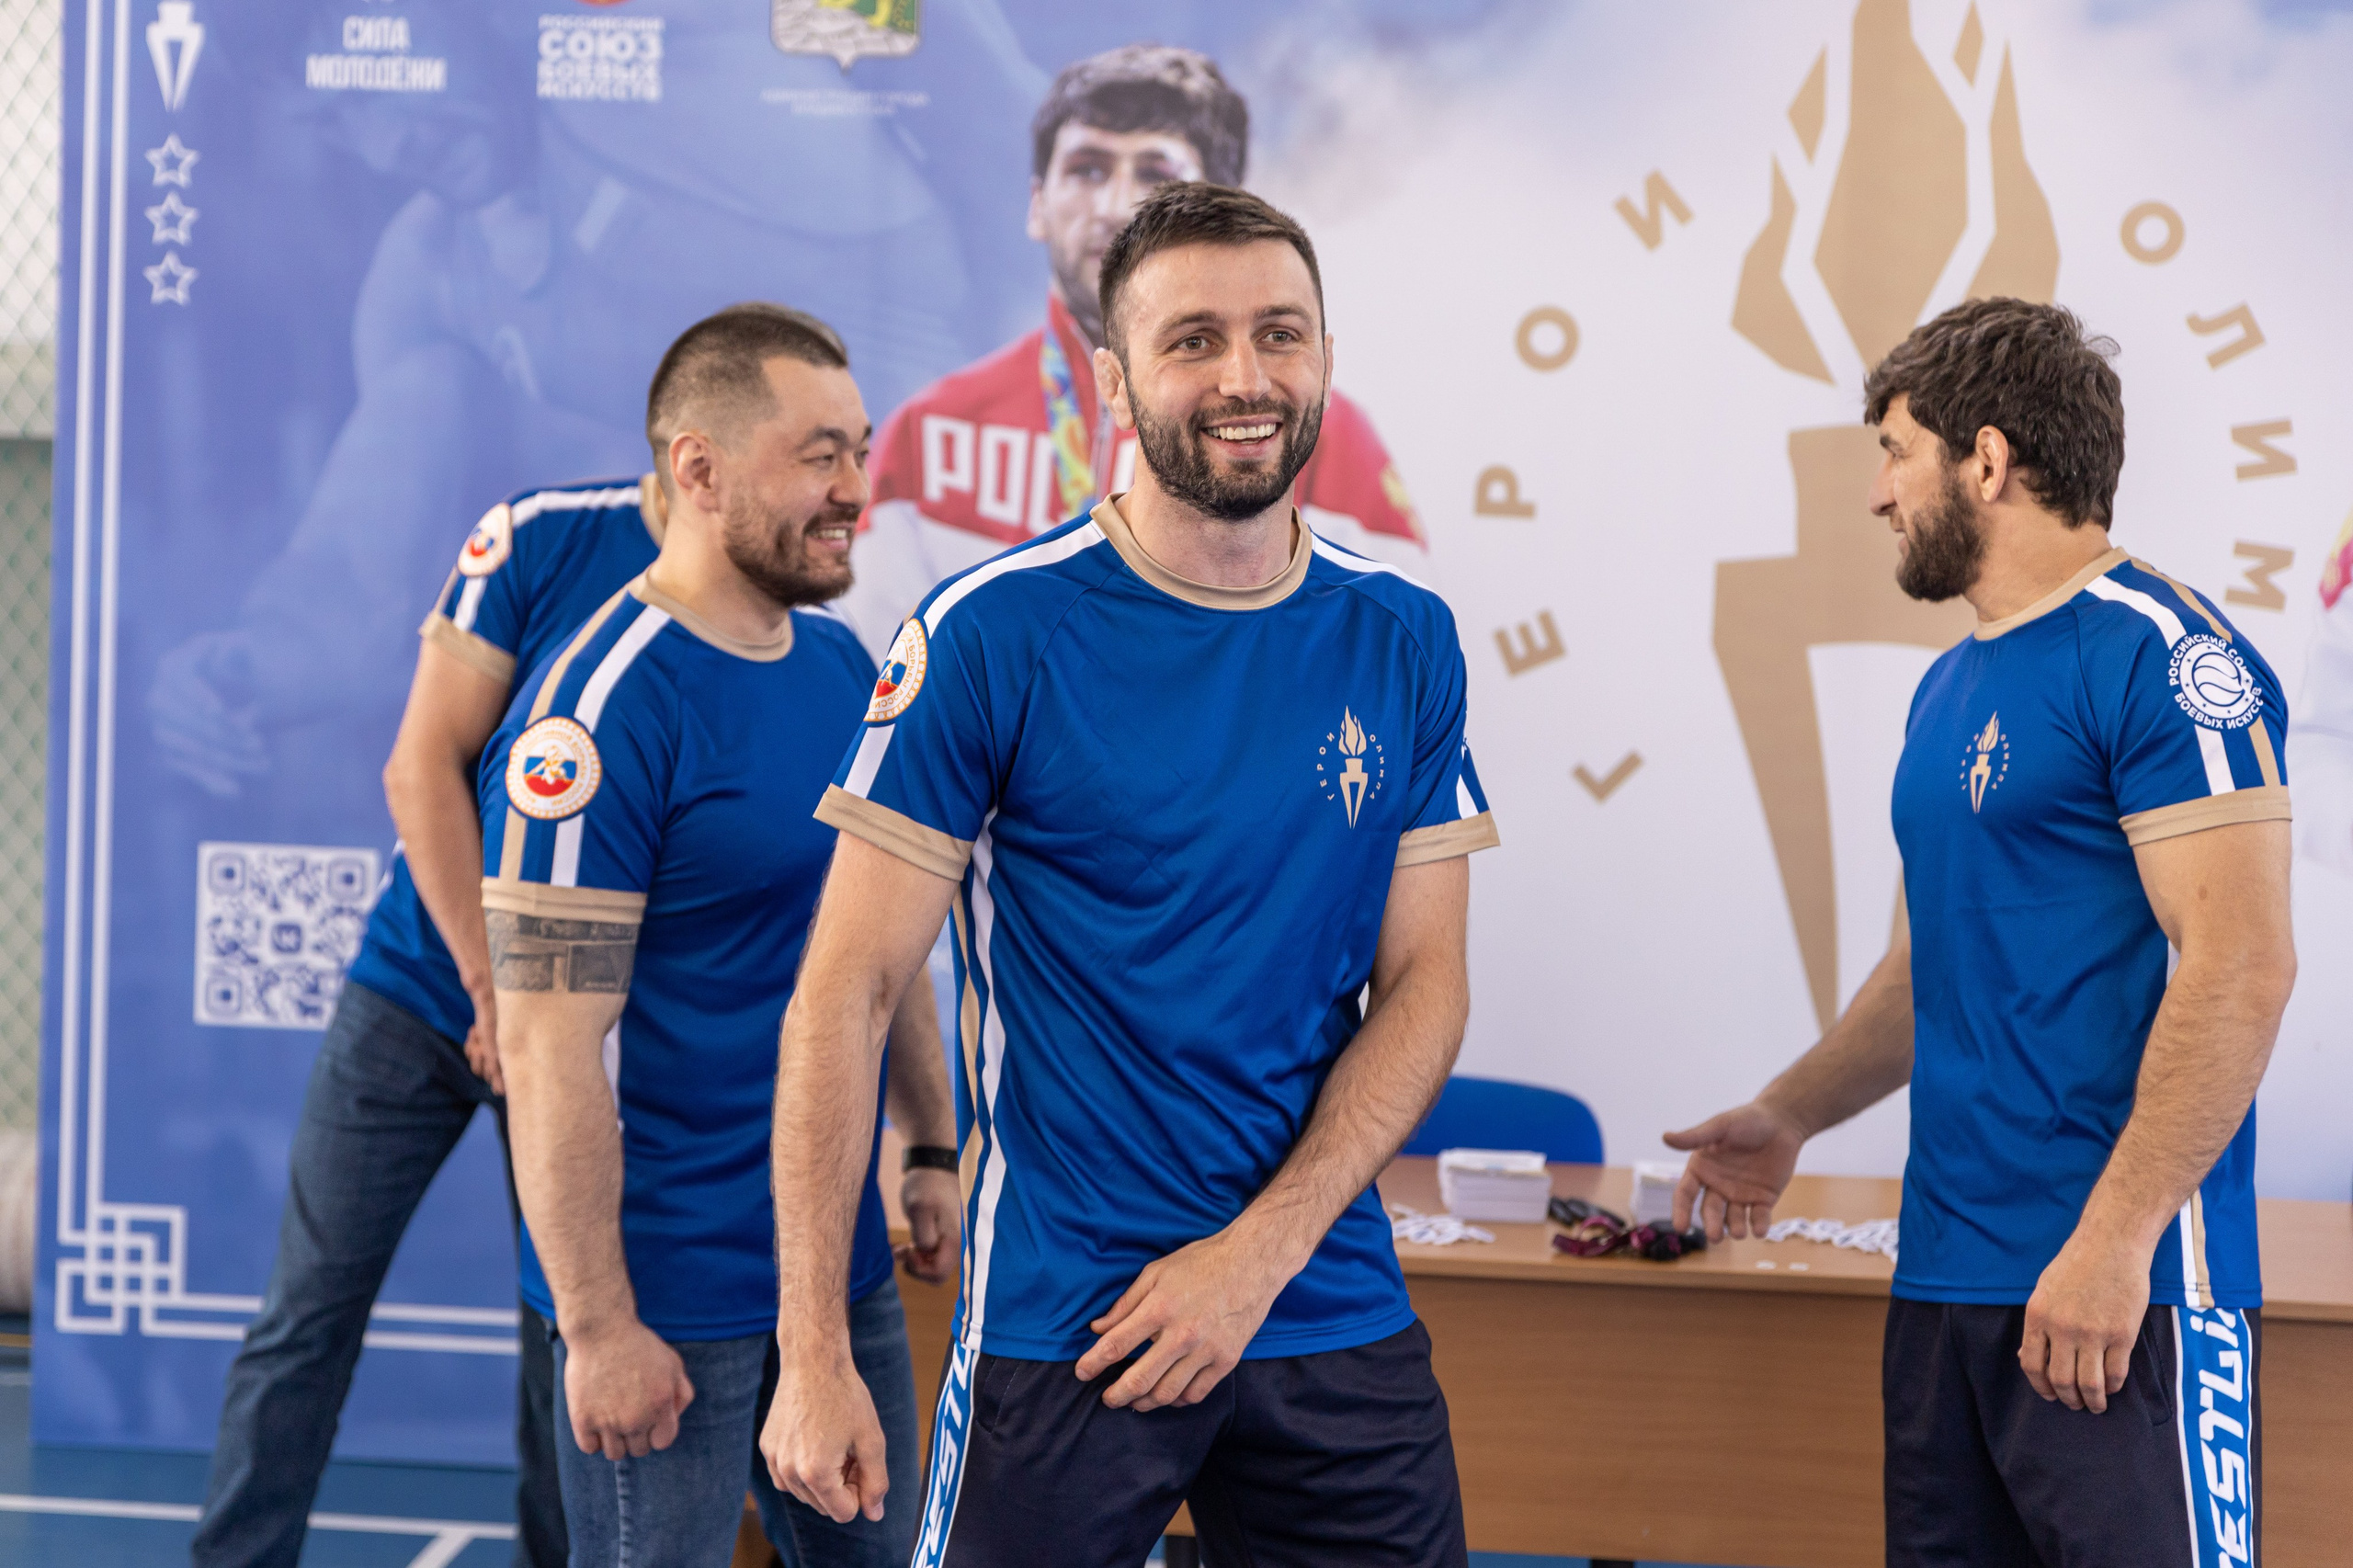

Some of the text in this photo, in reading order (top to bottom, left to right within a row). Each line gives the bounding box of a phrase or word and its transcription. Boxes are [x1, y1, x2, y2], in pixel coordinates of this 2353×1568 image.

[342, 16, 411, 50] СИЛА
[538, 30, 663, 61] СОЮЗ
[1473, 169, 2298, 804] ГЕРОИ ОЛИМ
[904, 644, 916, 685] БОРЬБЫ
[2168, 633, 2228, 687] РОССИЙСКИЙ
[874, 689, 904, 709] РОССИ
[2174, 687, 2264, 730] БОЕВЫХ ИСКУССВ
